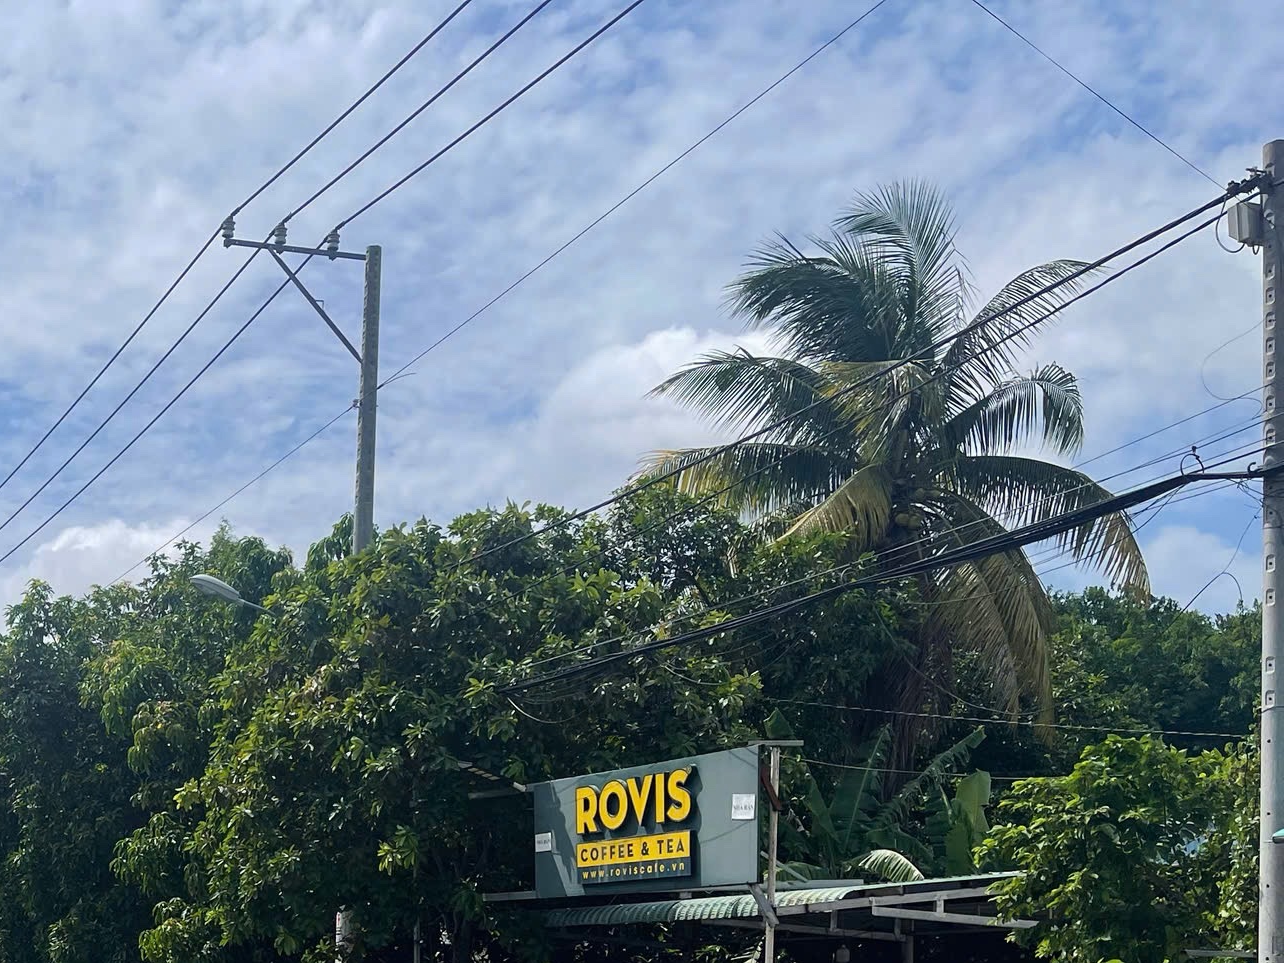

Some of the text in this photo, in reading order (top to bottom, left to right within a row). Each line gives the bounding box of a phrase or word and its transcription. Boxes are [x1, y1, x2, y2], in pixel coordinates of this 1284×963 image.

[576, 769, 692, 834] ROVIS
[580, 838, 685, 862] COFFEE & TEA
[582, 862, 685, 880] www.roviscafe.vn
